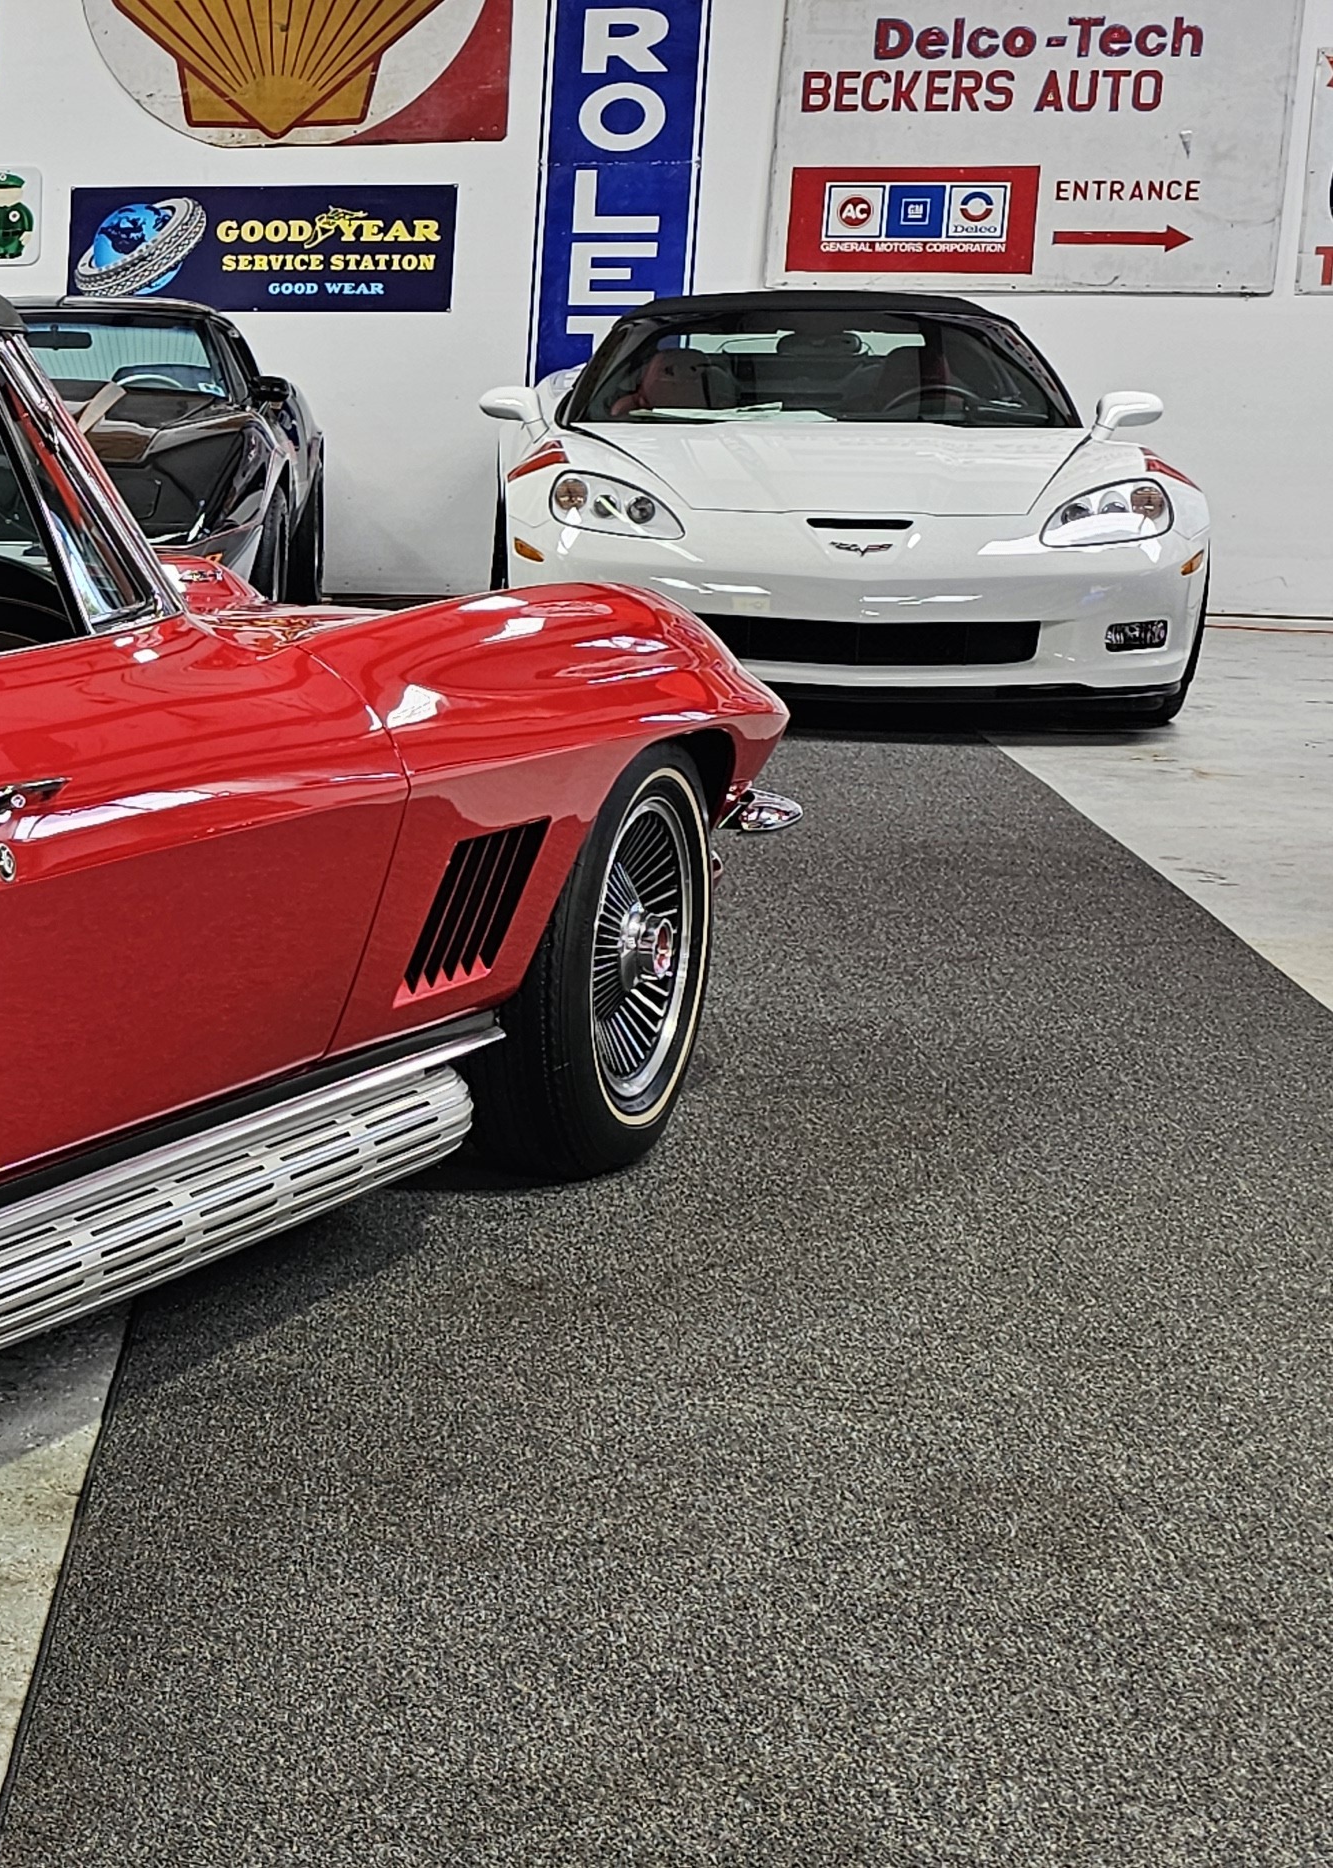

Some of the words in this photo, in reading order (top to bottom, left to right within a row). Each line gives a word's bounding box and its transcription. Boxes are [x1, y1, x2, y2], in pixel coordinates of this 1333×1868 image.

[801, 70, 1015, 112] BECKERS
[1034, 70, 1164, 112] AUTO
[1055, 180, 1200, 201] ENTRANCE
[842, 203, 869, 220] AC
[953, 224, 998, 234] Delco
[821, 242, 873, 252] GENERAL
[875, 242, 924, 252] MOTORS
[926, 242, 1006, 252] CORPORATION
[222, 254, 324, 271] SERVICE
[330, 254, 436, 271] STATION
[268, 283, 319, 295] GOOD
[325, 283, 384, 295] WEAR
